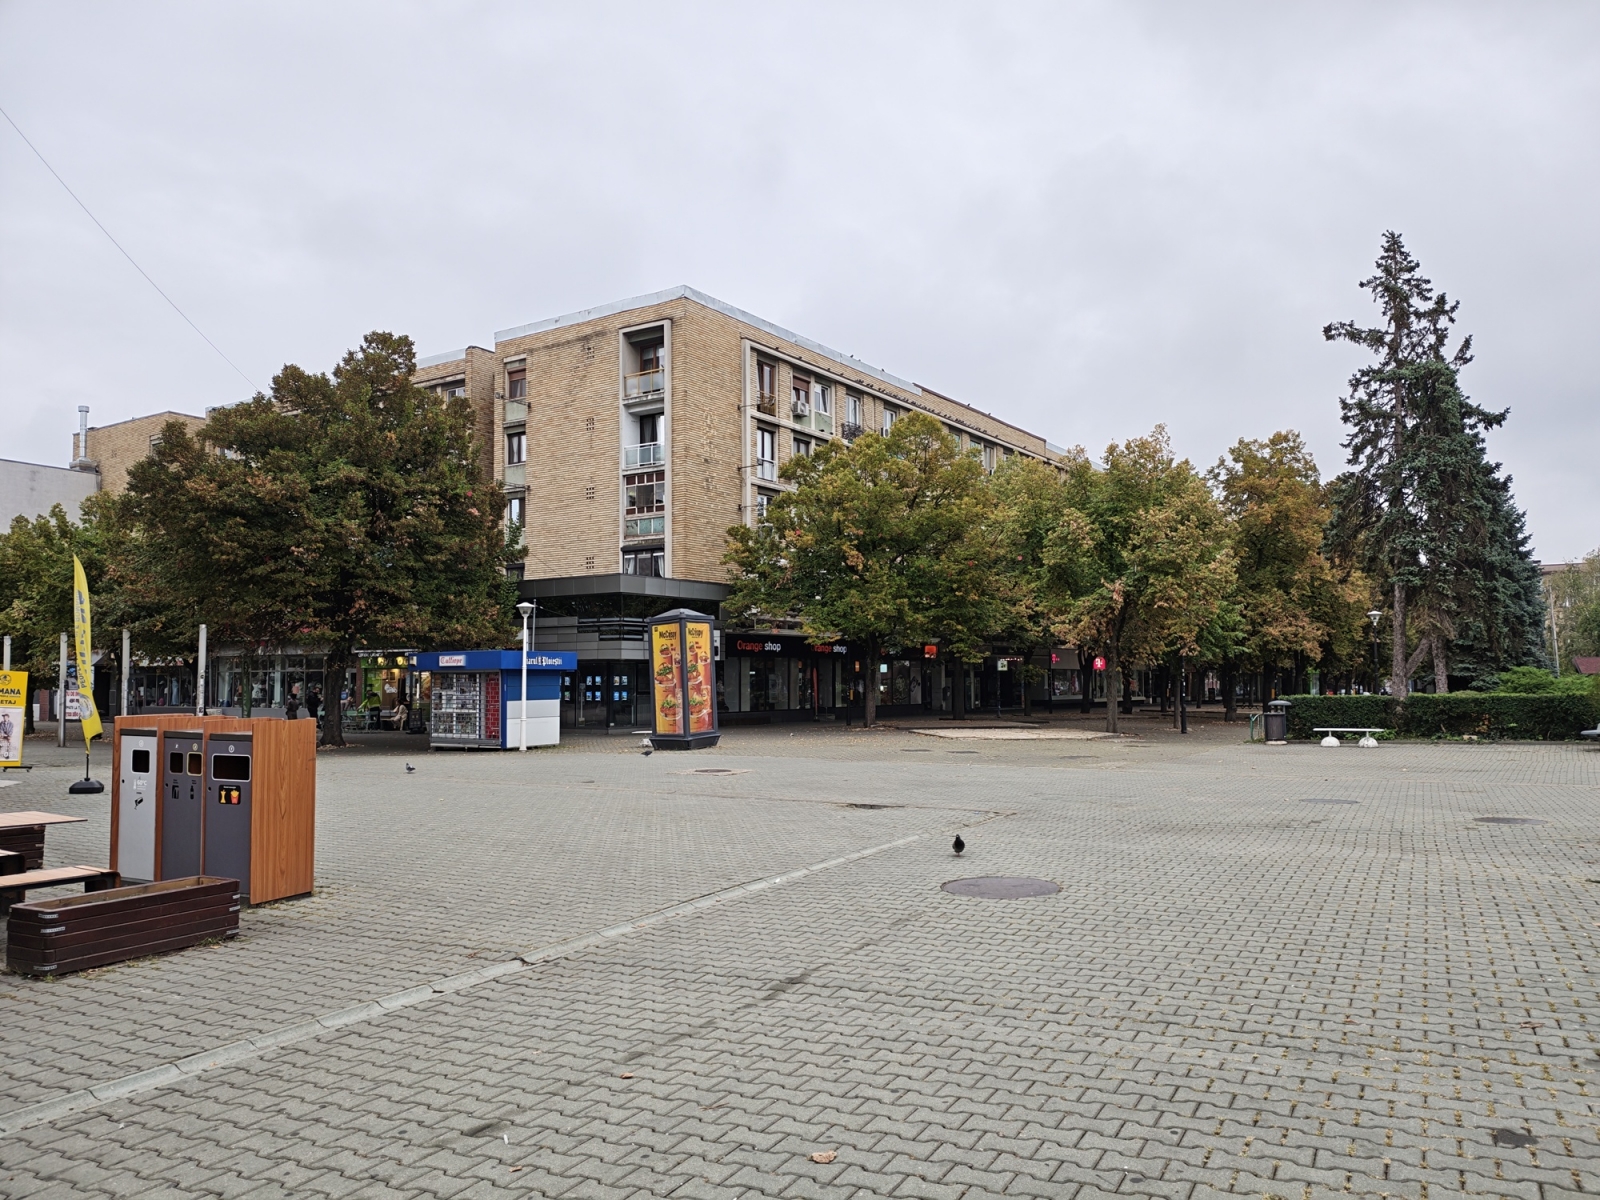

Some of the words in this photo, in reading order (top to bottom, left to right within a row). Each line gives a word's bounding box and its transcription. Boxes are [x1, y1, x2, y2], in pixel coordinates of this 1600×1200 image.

[737, 640, 763, 652] Orange
[764, 641, 782, 652] shop
[833, 644, 848, 655] shop
[526, 656, 538, 665] iarul
